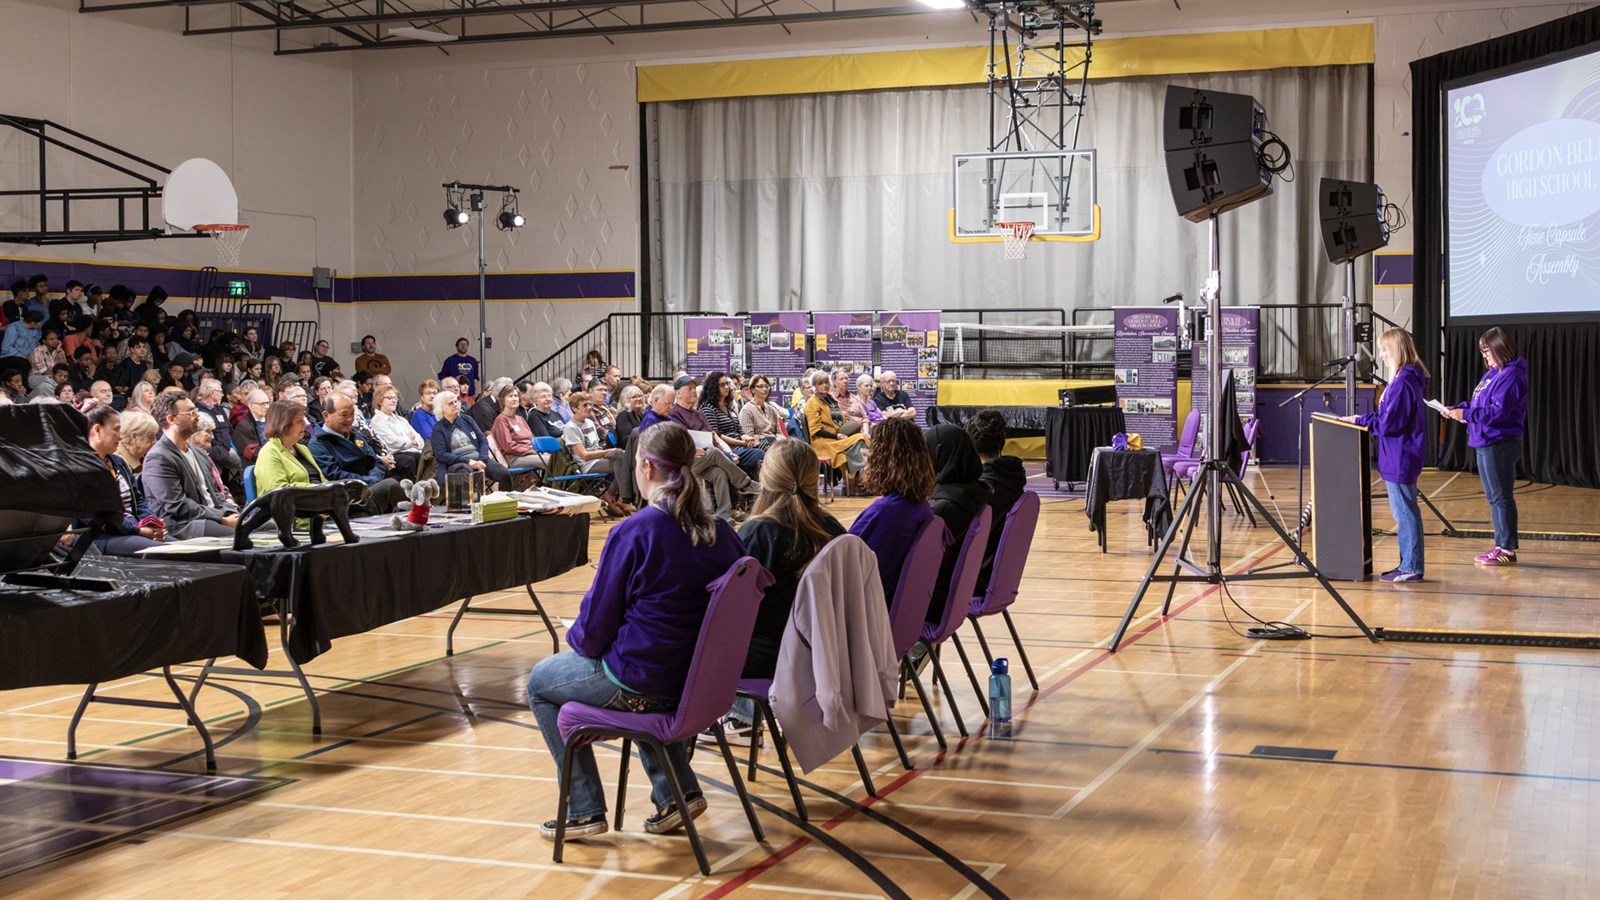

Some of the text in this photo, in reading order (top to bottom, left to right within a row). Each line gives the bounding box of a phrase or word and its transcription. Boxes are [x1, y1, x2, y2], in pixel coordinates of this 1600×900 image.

[1496, 137, 1600, 177] GORDON BEL
[1506, 169, 1597, 201] HIGH SCHOOL
[1519, 221, 1587, 251] Time Capsule
[1526, 254, 1580, 284] Assembly
